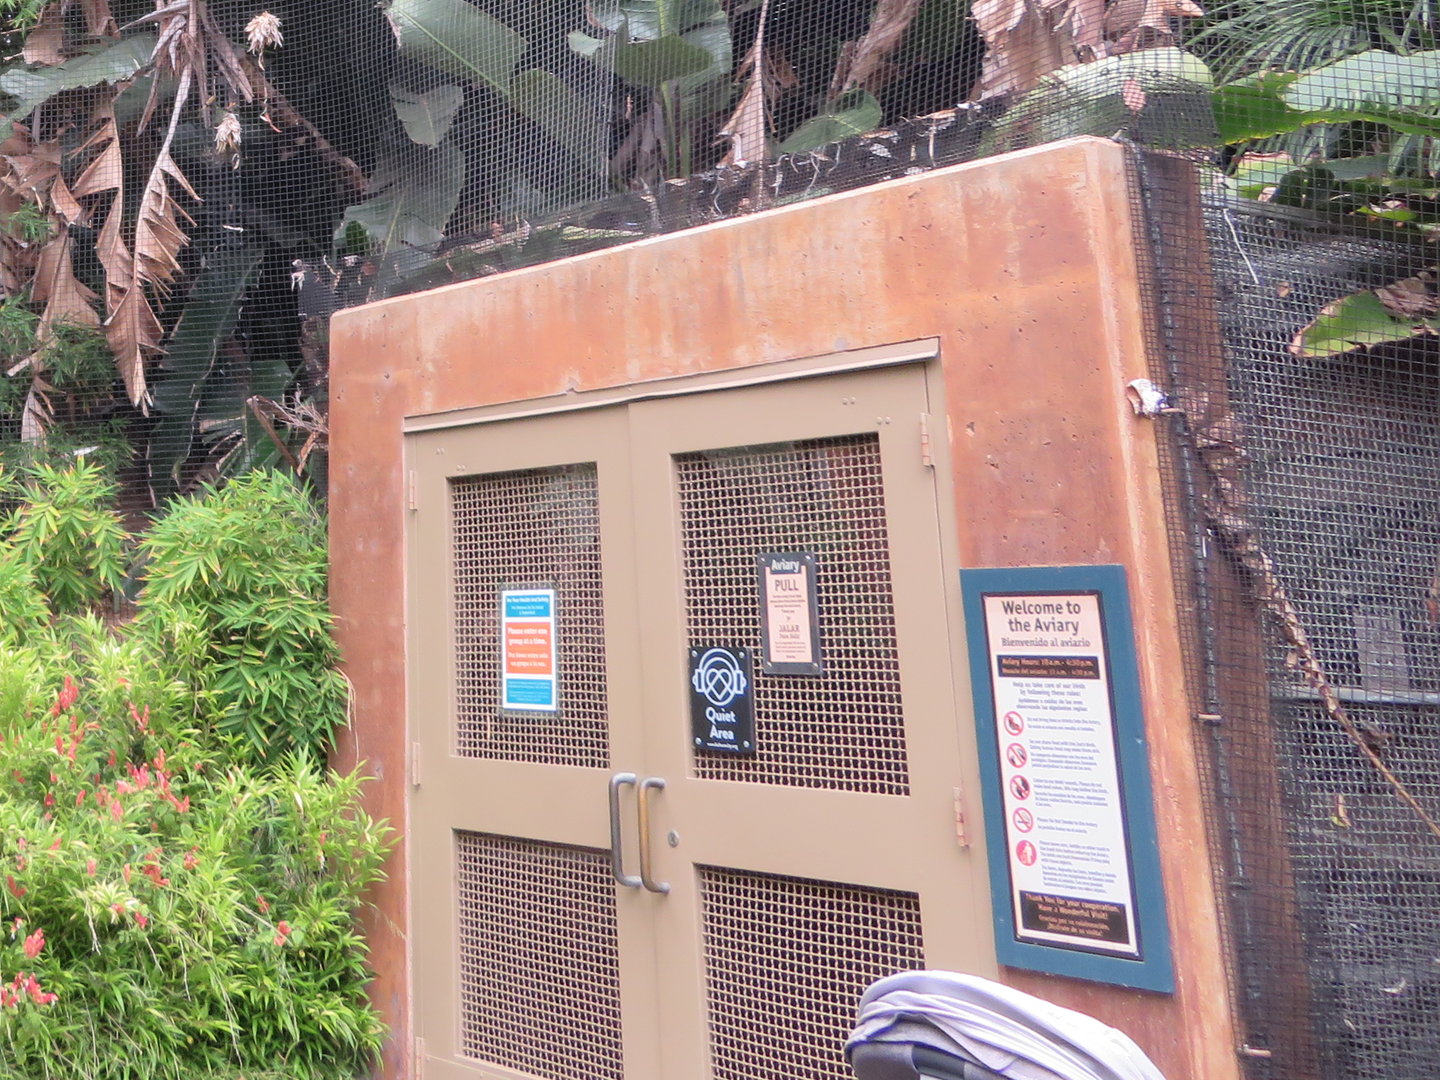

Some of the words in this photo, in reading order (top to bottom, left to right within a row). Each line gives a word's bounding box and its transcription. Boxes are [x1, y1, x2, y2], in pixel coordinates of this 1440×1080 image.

[772, 559, 799, 572] Aviary
[775, 579, 799, 591] PULL
[1002, 600, 1063, 615] Welcome
[1066, 601, 1081, 615] to
[1008, 618, 1031, 632] the
[1035, 618, 1079, 636] Aviary
[1001, 637, 1049, 648] Bienvenido
[1050, 638, 1058, 648] al
[1061, 638, 1091, 648] aviario
[706, 707, 736, 725] Quiet
[710, 725, 734, 740] Area
